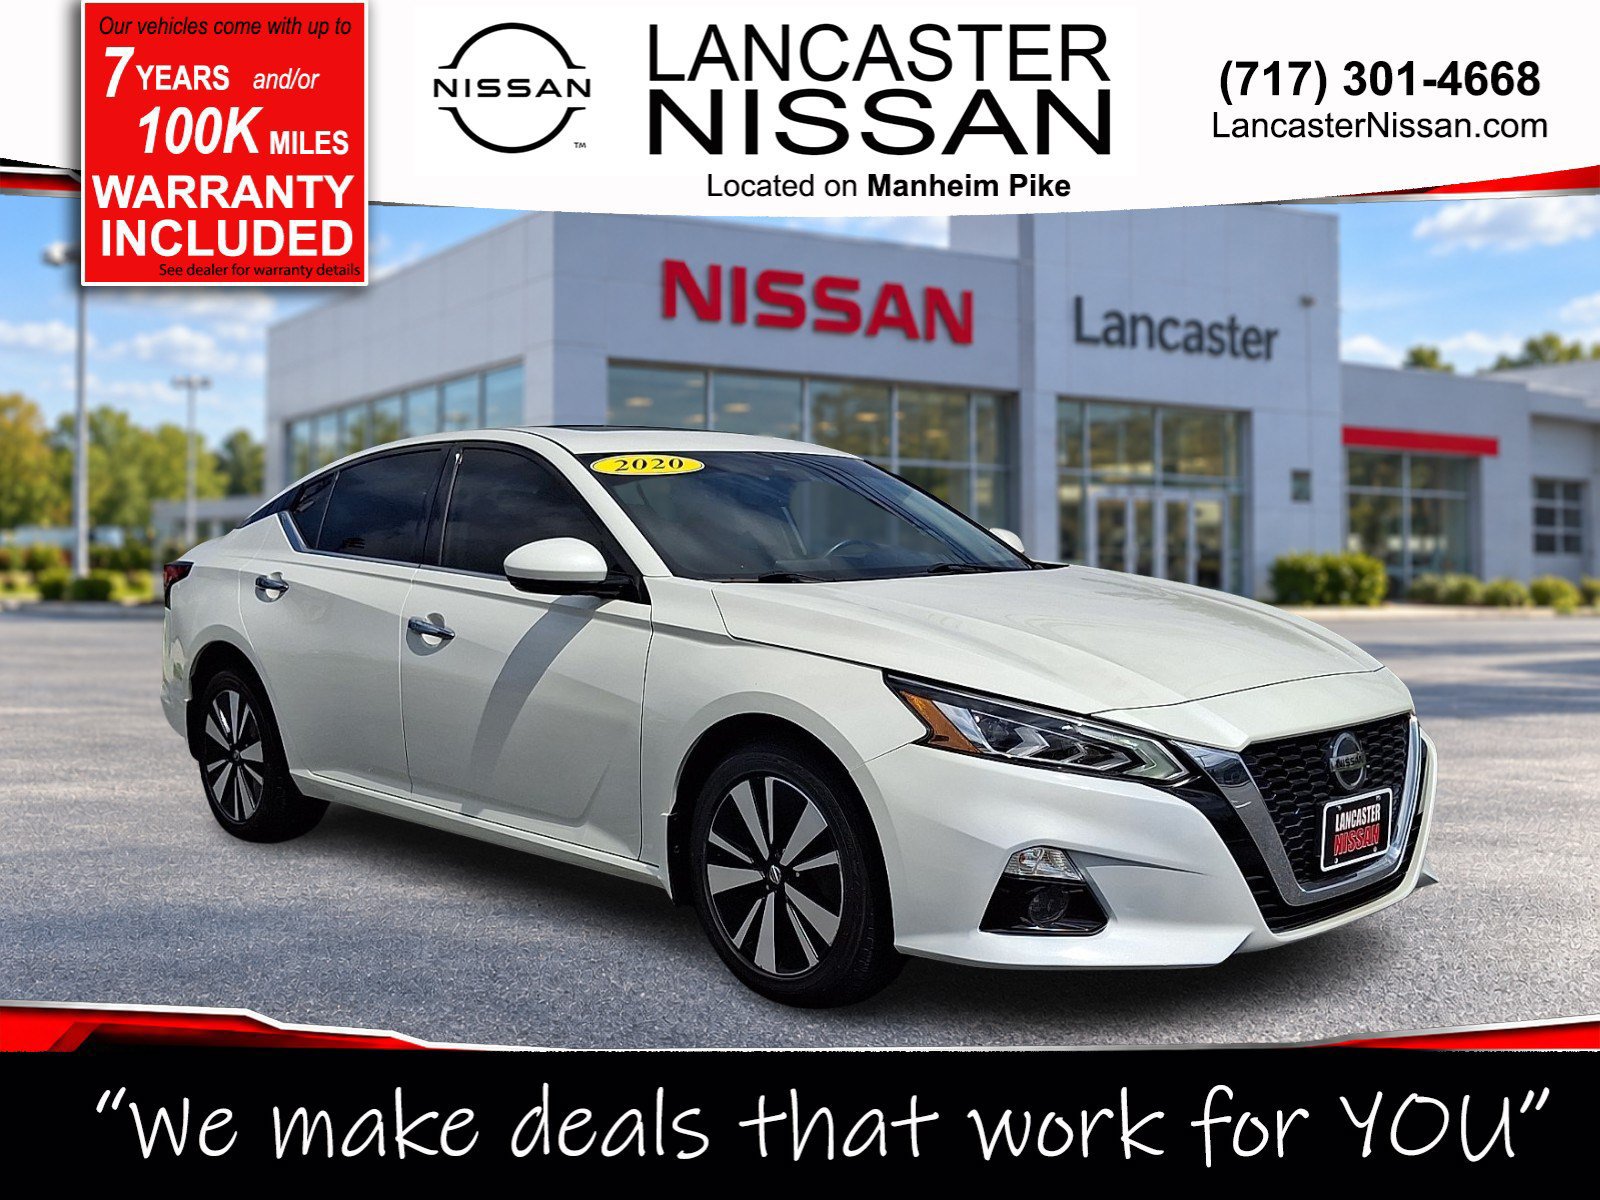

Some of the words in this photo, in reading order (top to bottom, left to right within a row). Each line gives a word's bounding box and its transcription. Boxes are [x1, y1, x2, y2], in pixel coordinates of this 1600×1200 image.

[662, 257, 975, 346] NISSAN
[1073, 294, 1280, 362] Lancaster
[614, 458, 684, 472] 2020
[1335, 803, 1381, 833] LANCASTER
[1334, 823, 1380, 856] NISSAN
